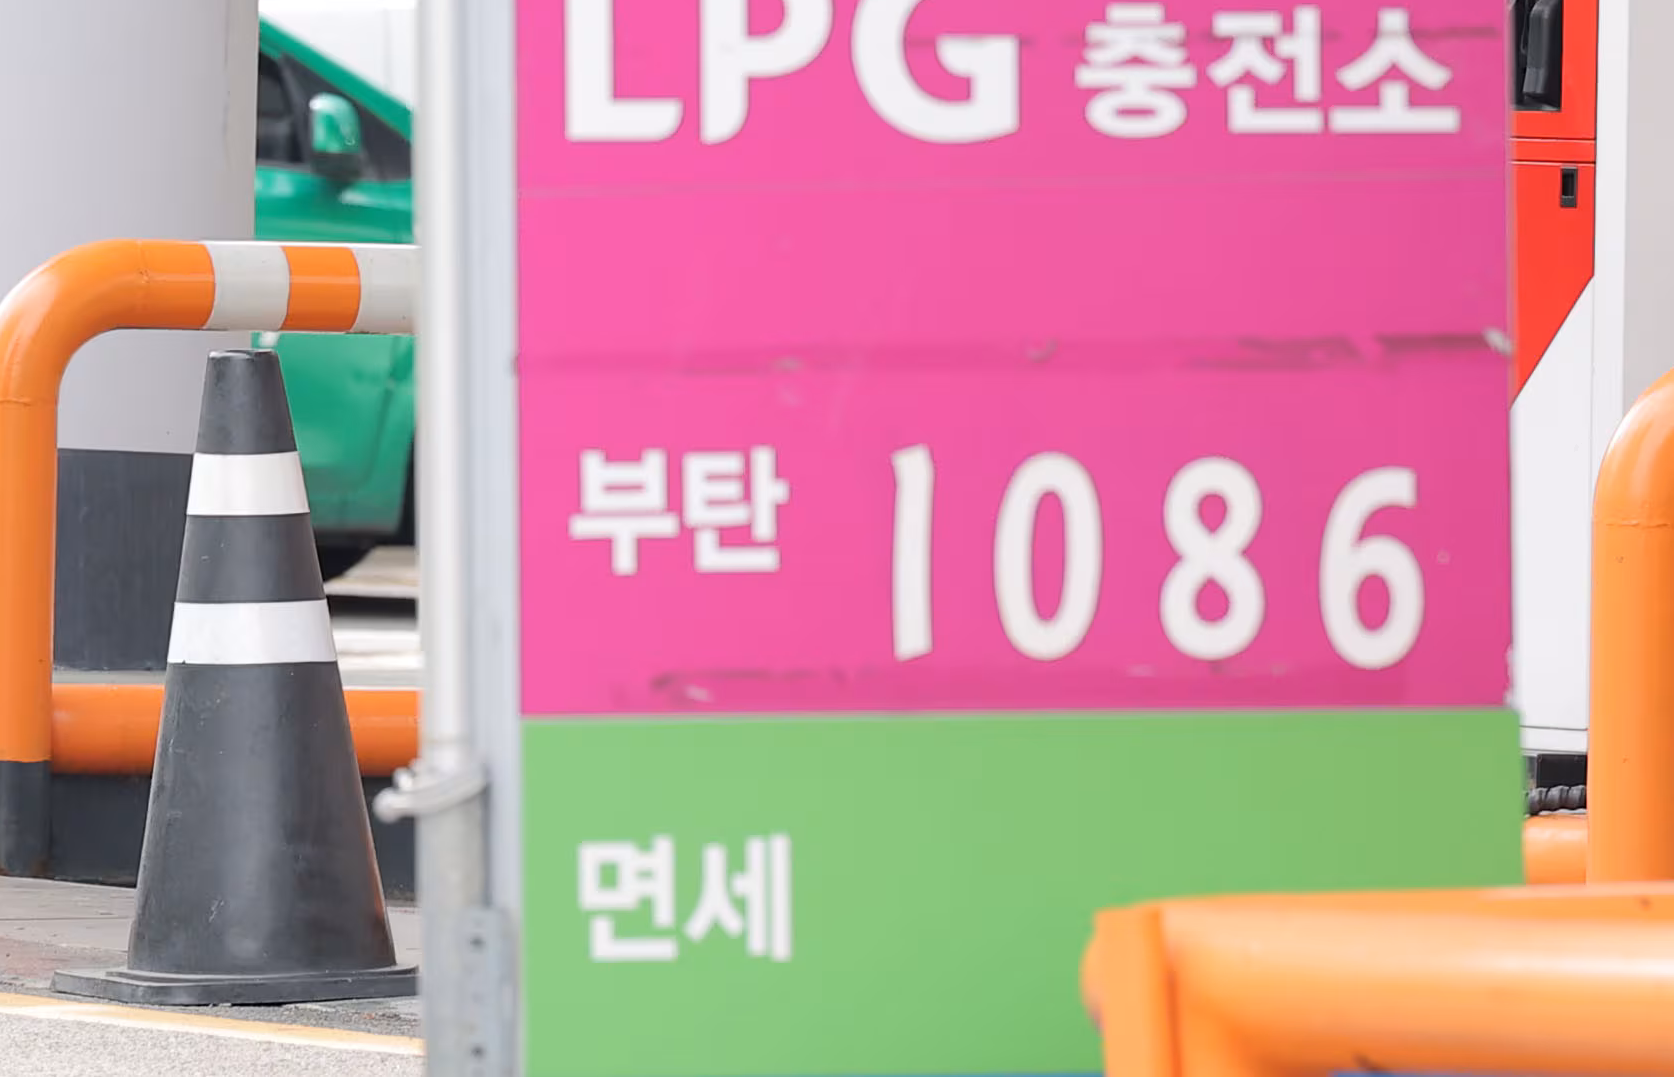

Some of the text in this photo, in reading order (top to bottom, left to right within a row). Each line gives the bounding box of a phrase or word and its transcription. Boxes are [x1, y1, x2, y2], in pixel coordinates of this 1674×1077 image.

[1073, 2, 1461, 139] 충전소
[569, 444, 1426, 670] 부탄 1086
[577, 834, 792, 962] 면세
